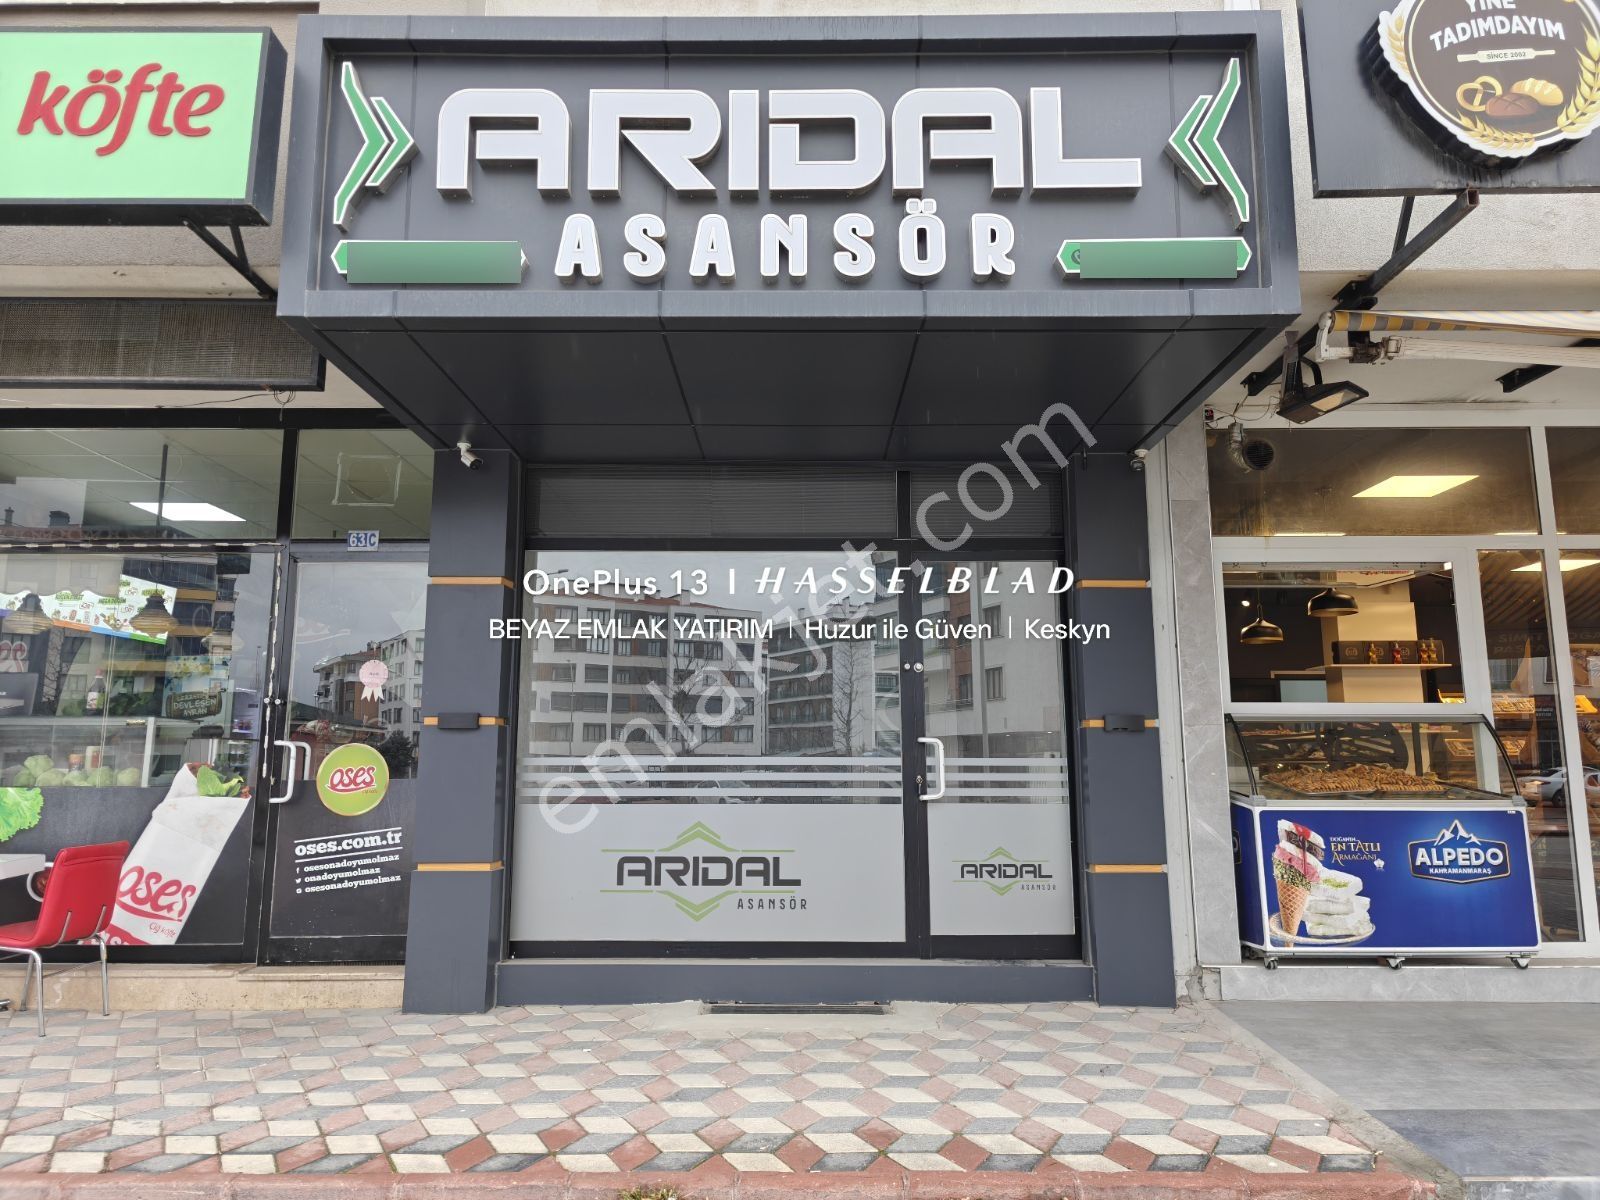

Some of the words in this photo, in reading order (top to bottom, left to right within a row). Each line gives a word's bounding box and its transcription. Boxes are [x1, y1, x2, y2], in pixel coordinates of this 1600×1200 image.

[1429, 15, 1566, 51] TADIMDAYIM
[17, 63, 225, 157] köfte
[436, 87, 1142, 193] ARIDAL
[554, 198, 1016, 279] ASANSÖR
[294, 831, 403, 857] oses.com.tr
[304, 854, 400, 872] osesonadoyumolmaz
[1415, 847, 1504, 866] ALPEDO
[304, 867, 381, 883] onadoyumolmaz
[617, 856, 802, 886] ARIDAL
[960, 864, 1053, 878] ARIDAL
[304, 875, 401, 893] osesonadoyumolmaz
[737, 896, 807, 910] ASANSÖR
